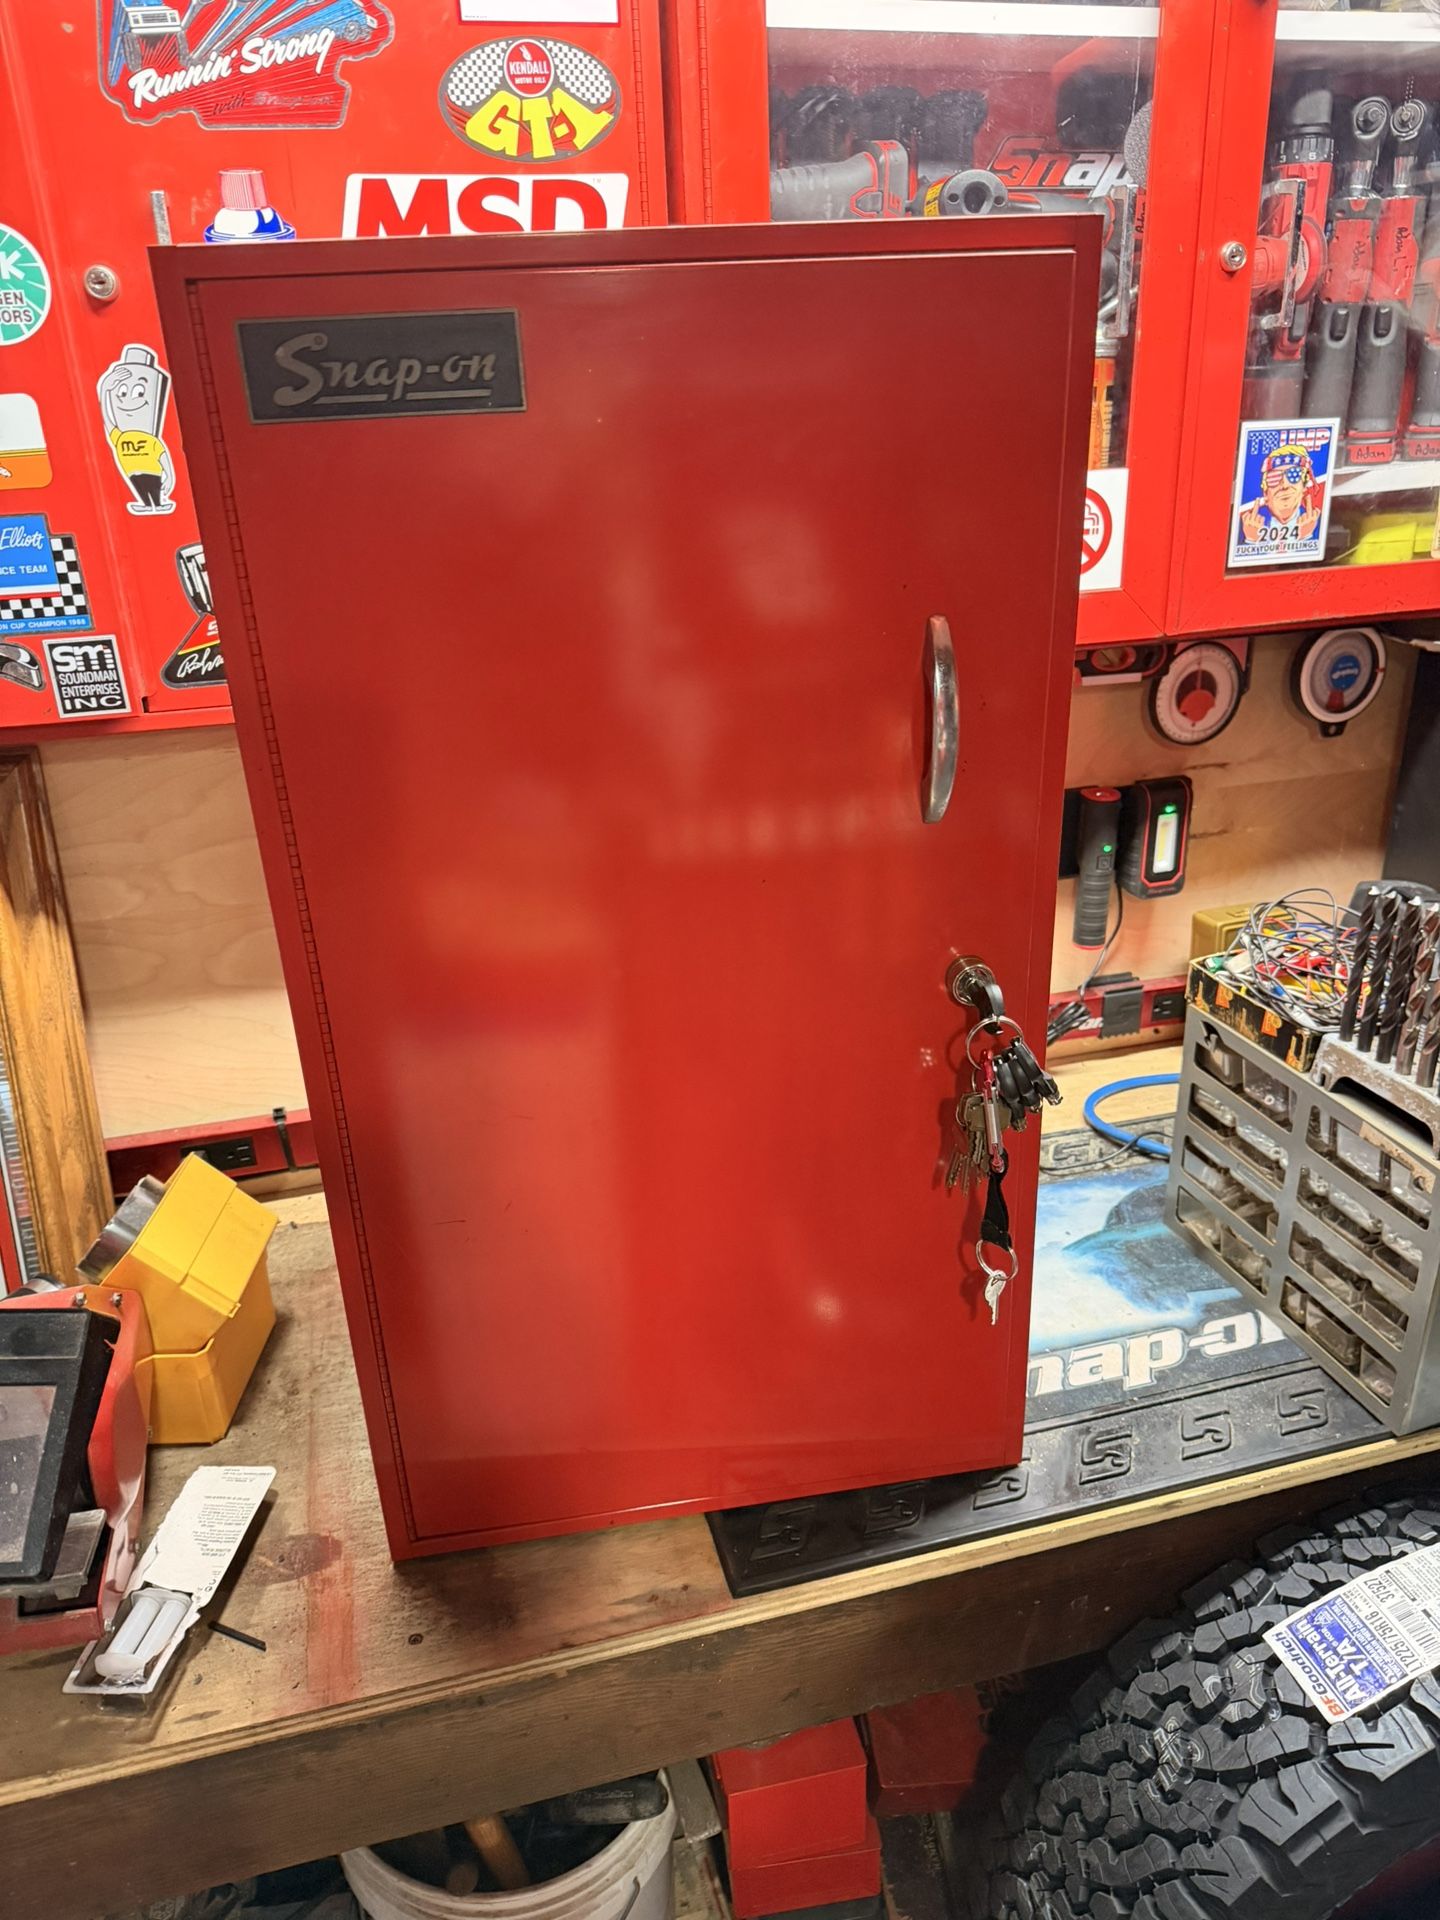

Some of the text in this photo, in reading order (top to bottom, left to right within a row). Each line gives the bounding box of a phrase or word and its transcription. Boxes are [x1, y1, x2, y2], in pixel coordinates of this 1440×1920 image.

[129, 28, 336, 108] Runnin' Strong
[509, 61, 549, 75] KENDALL
[273, 333, 496, 406] Snap-on
[1356, 446, 1386, 460] Adam
[0, 526, 44, 550] Elliott
[1259, 525, 1300, 542] 2024
[1236, 541, 1318, 554] FUCK YOUR FEELINGS
[19, 564, 48, 574] TEAM
[10, 622, 25, 630] CUP
[28, 621, 67, 629] CHAMPION
[59, 670, 117, 685] SOUNDMAN
[61, 682, 121, 698] ENTERPRISES
[64, 695, 122, 710] INC
[1363, 1576, 1394, 1603] 37527
[1364, 1609, 1423, 1673] LT225/75R16
[1293, 1618, 1366, 1701] All-Terrain
[1271, 1630, 1344, 1717] BFGoodrich
